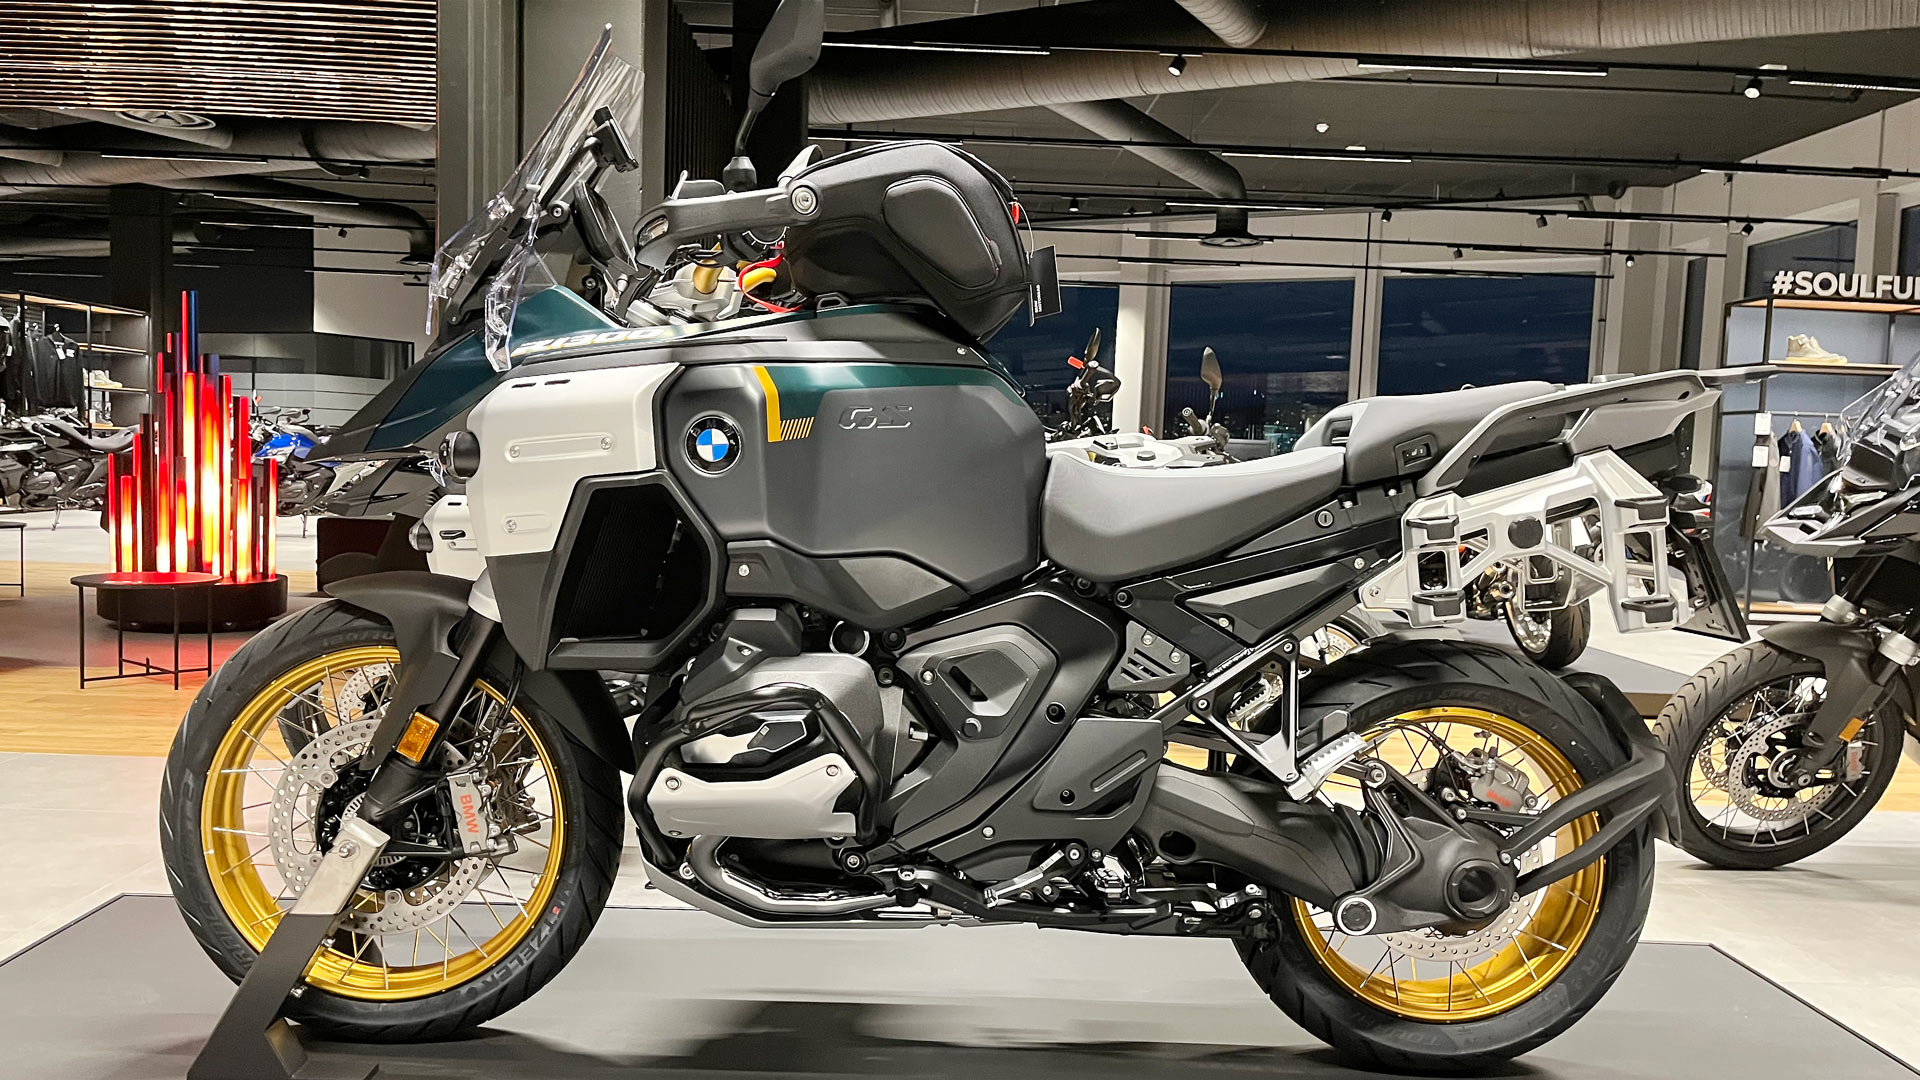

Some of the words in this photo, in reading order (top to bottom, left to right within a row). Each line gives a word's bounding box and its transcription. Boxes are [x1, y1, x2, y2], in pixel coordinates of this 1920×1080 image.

[838, 405, 914, 430] GS
[690, 418, 737, 446] BMW
[459, 793, 481, 835] BMW
